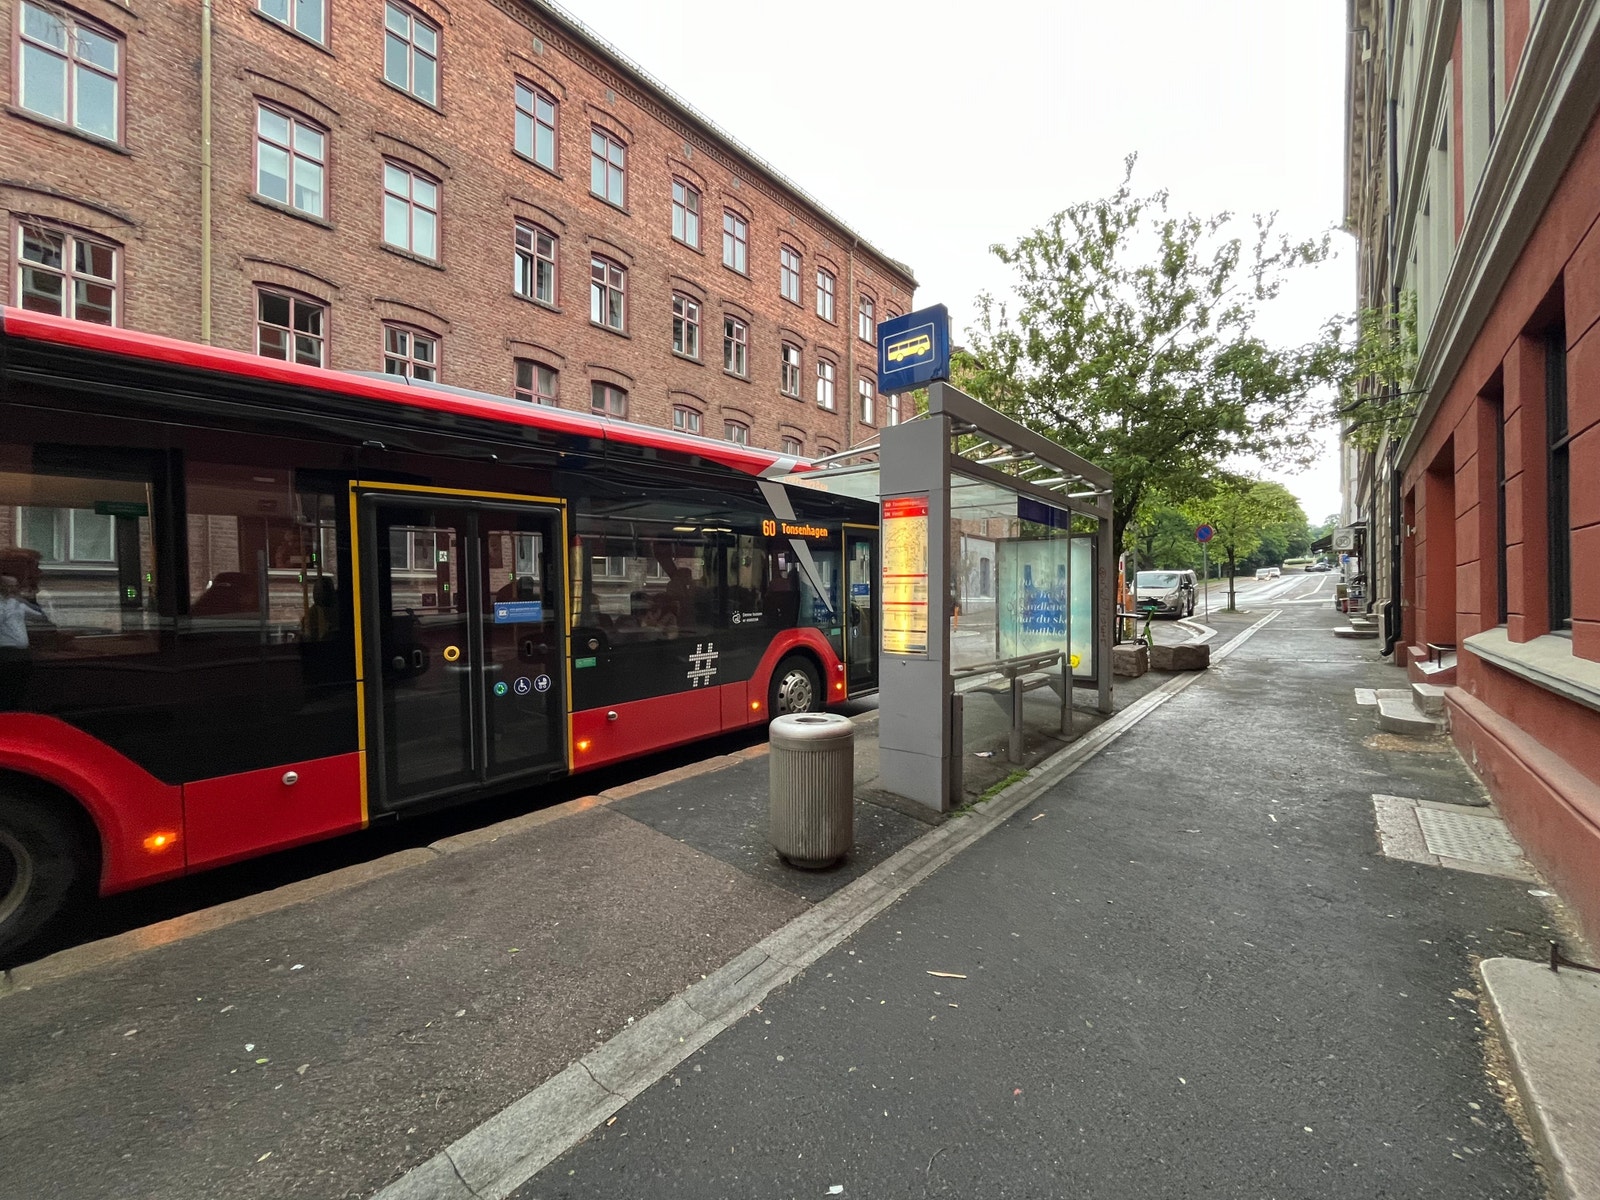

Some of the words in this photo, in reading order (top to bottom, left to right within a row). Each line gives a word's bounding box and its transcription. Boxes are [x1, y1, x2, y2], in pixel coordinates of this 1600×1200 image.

[762, 519, 776, 537] 60
[781, 522, 829, 539] Tonsenhagen
[1036, 614, 1051, 623] du
